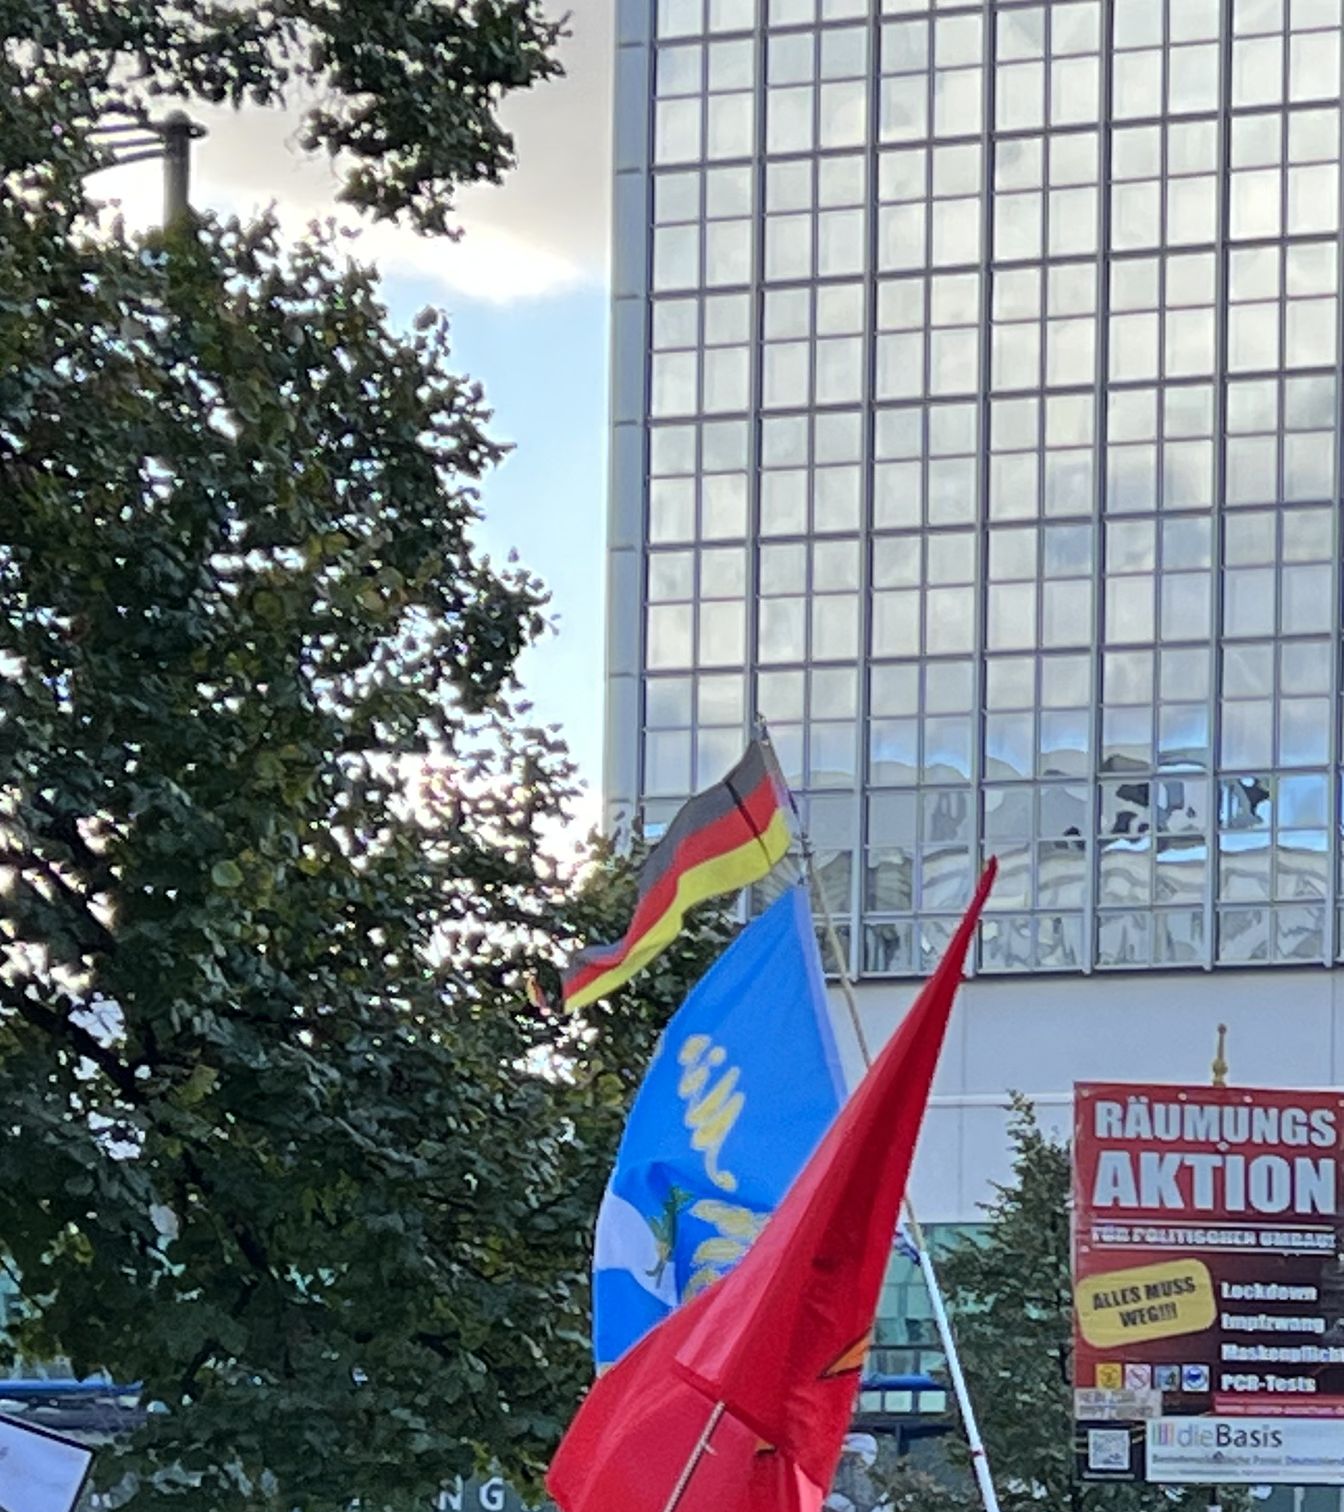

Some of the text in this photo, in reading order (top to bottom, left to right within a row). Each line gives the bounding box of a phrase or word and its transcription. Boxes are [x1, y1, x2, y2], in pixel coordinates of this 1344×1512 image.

[1095, 1095, 1337, 1147] RÄUMUNGS
[1092, 1150, 1336, 1215] AKTION
[1092, 1275, 1197, 1311] ALLES MUSS
[1221, 1281, 1318, 1301] Lockdown
[1118, 1301, 1179, 1328] WEG!!!
[1221, 1373, 1317, 1393] PCR-Tests
